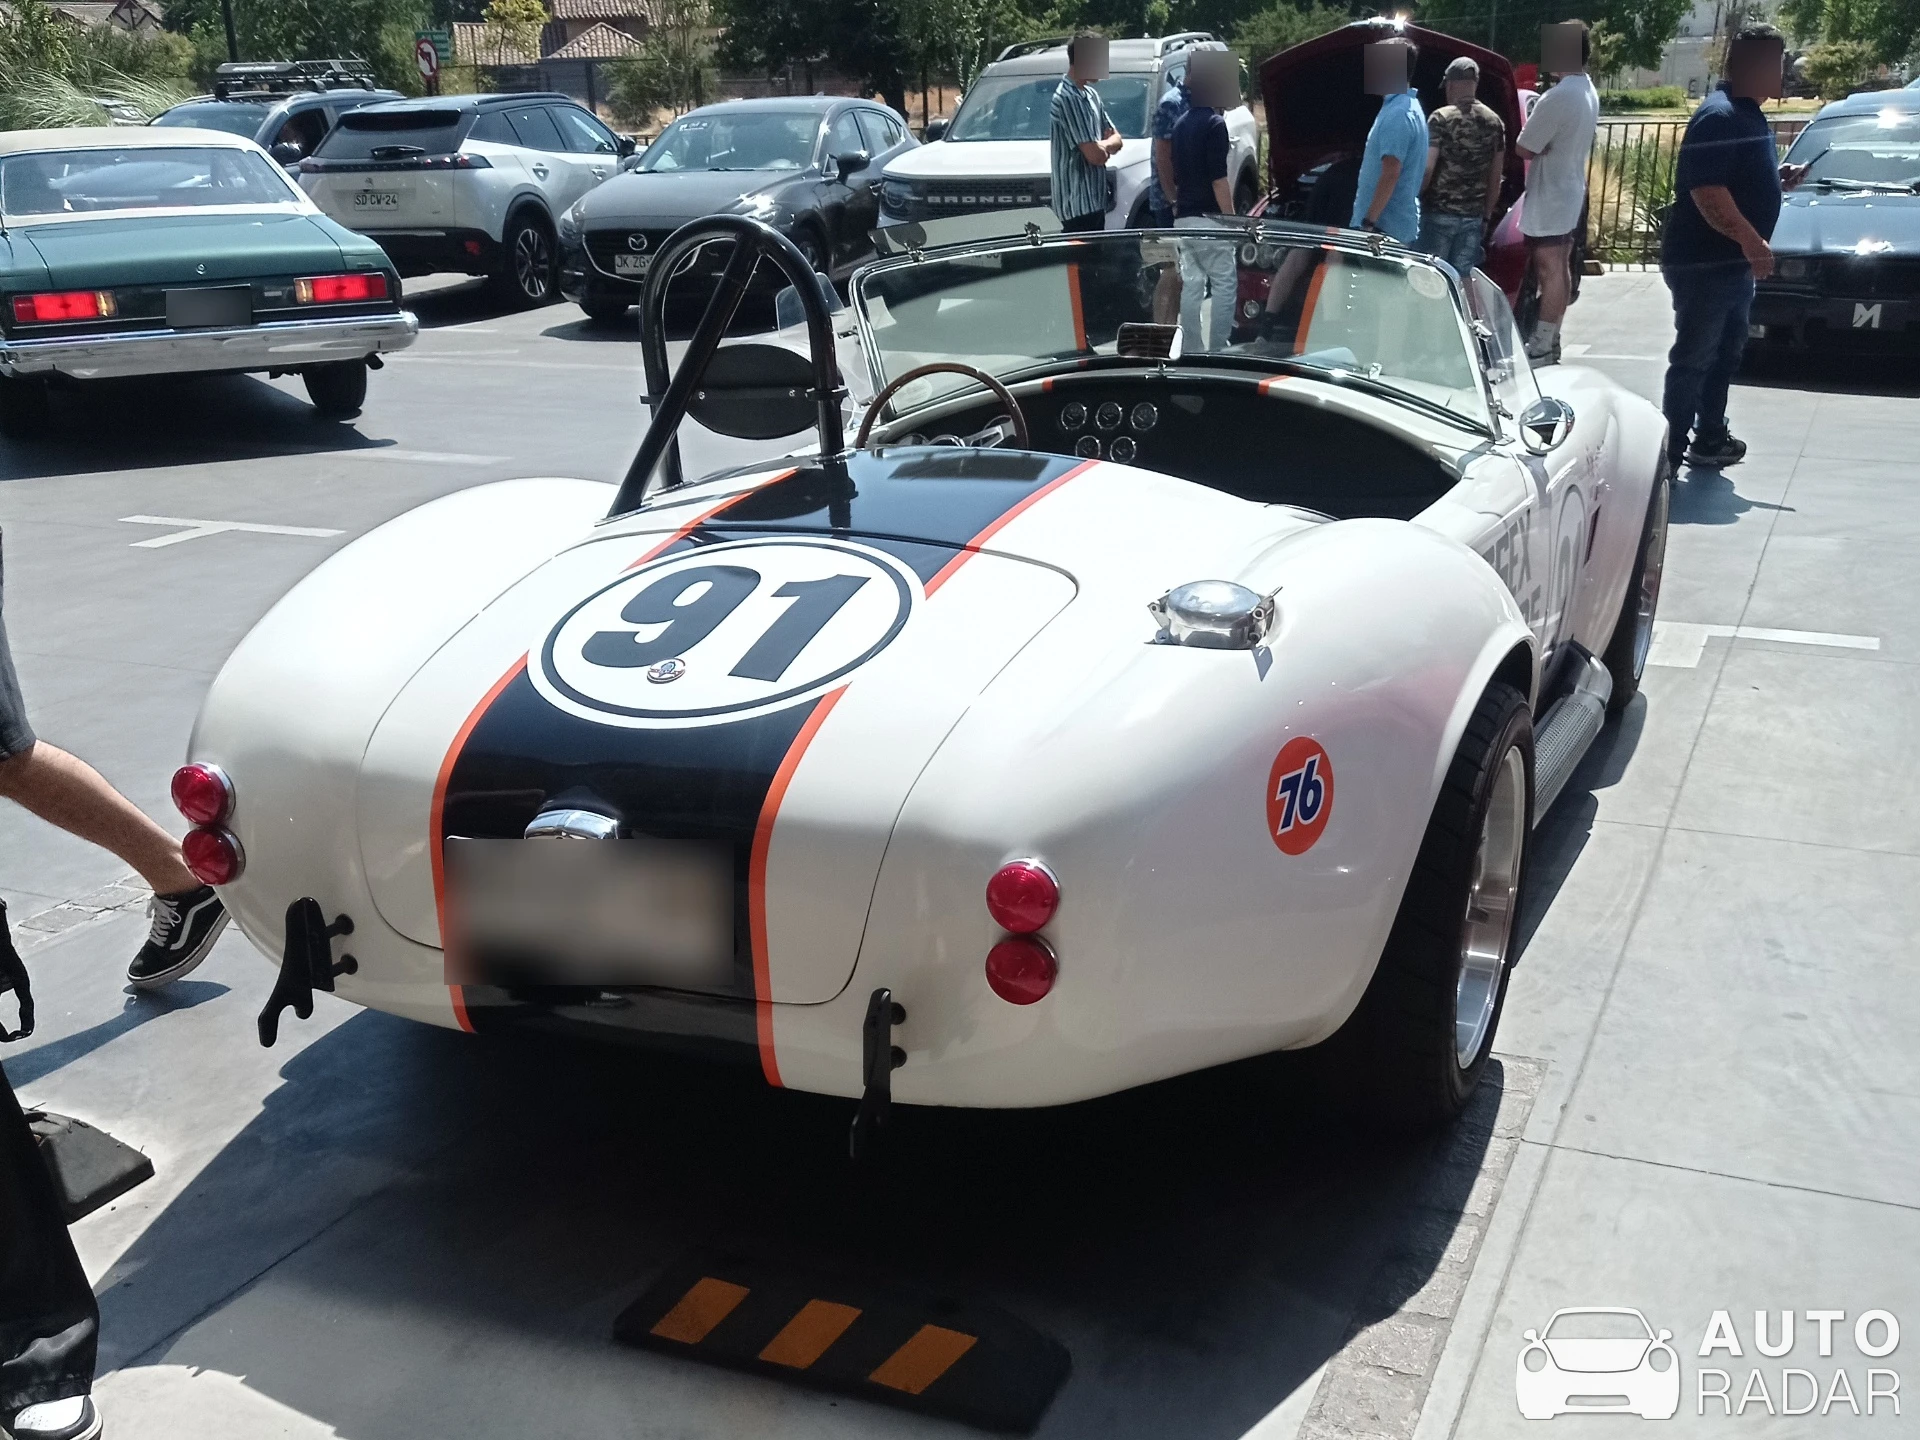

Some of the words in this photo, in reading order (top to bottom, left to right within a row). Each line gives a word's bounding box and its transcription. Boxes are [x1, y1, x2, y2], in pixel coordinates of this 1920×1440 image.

[927, 195, 1032, 203] BRONCO
[581, 565, 871, 682] 91
[1276, 753, 1324, 835] 76
